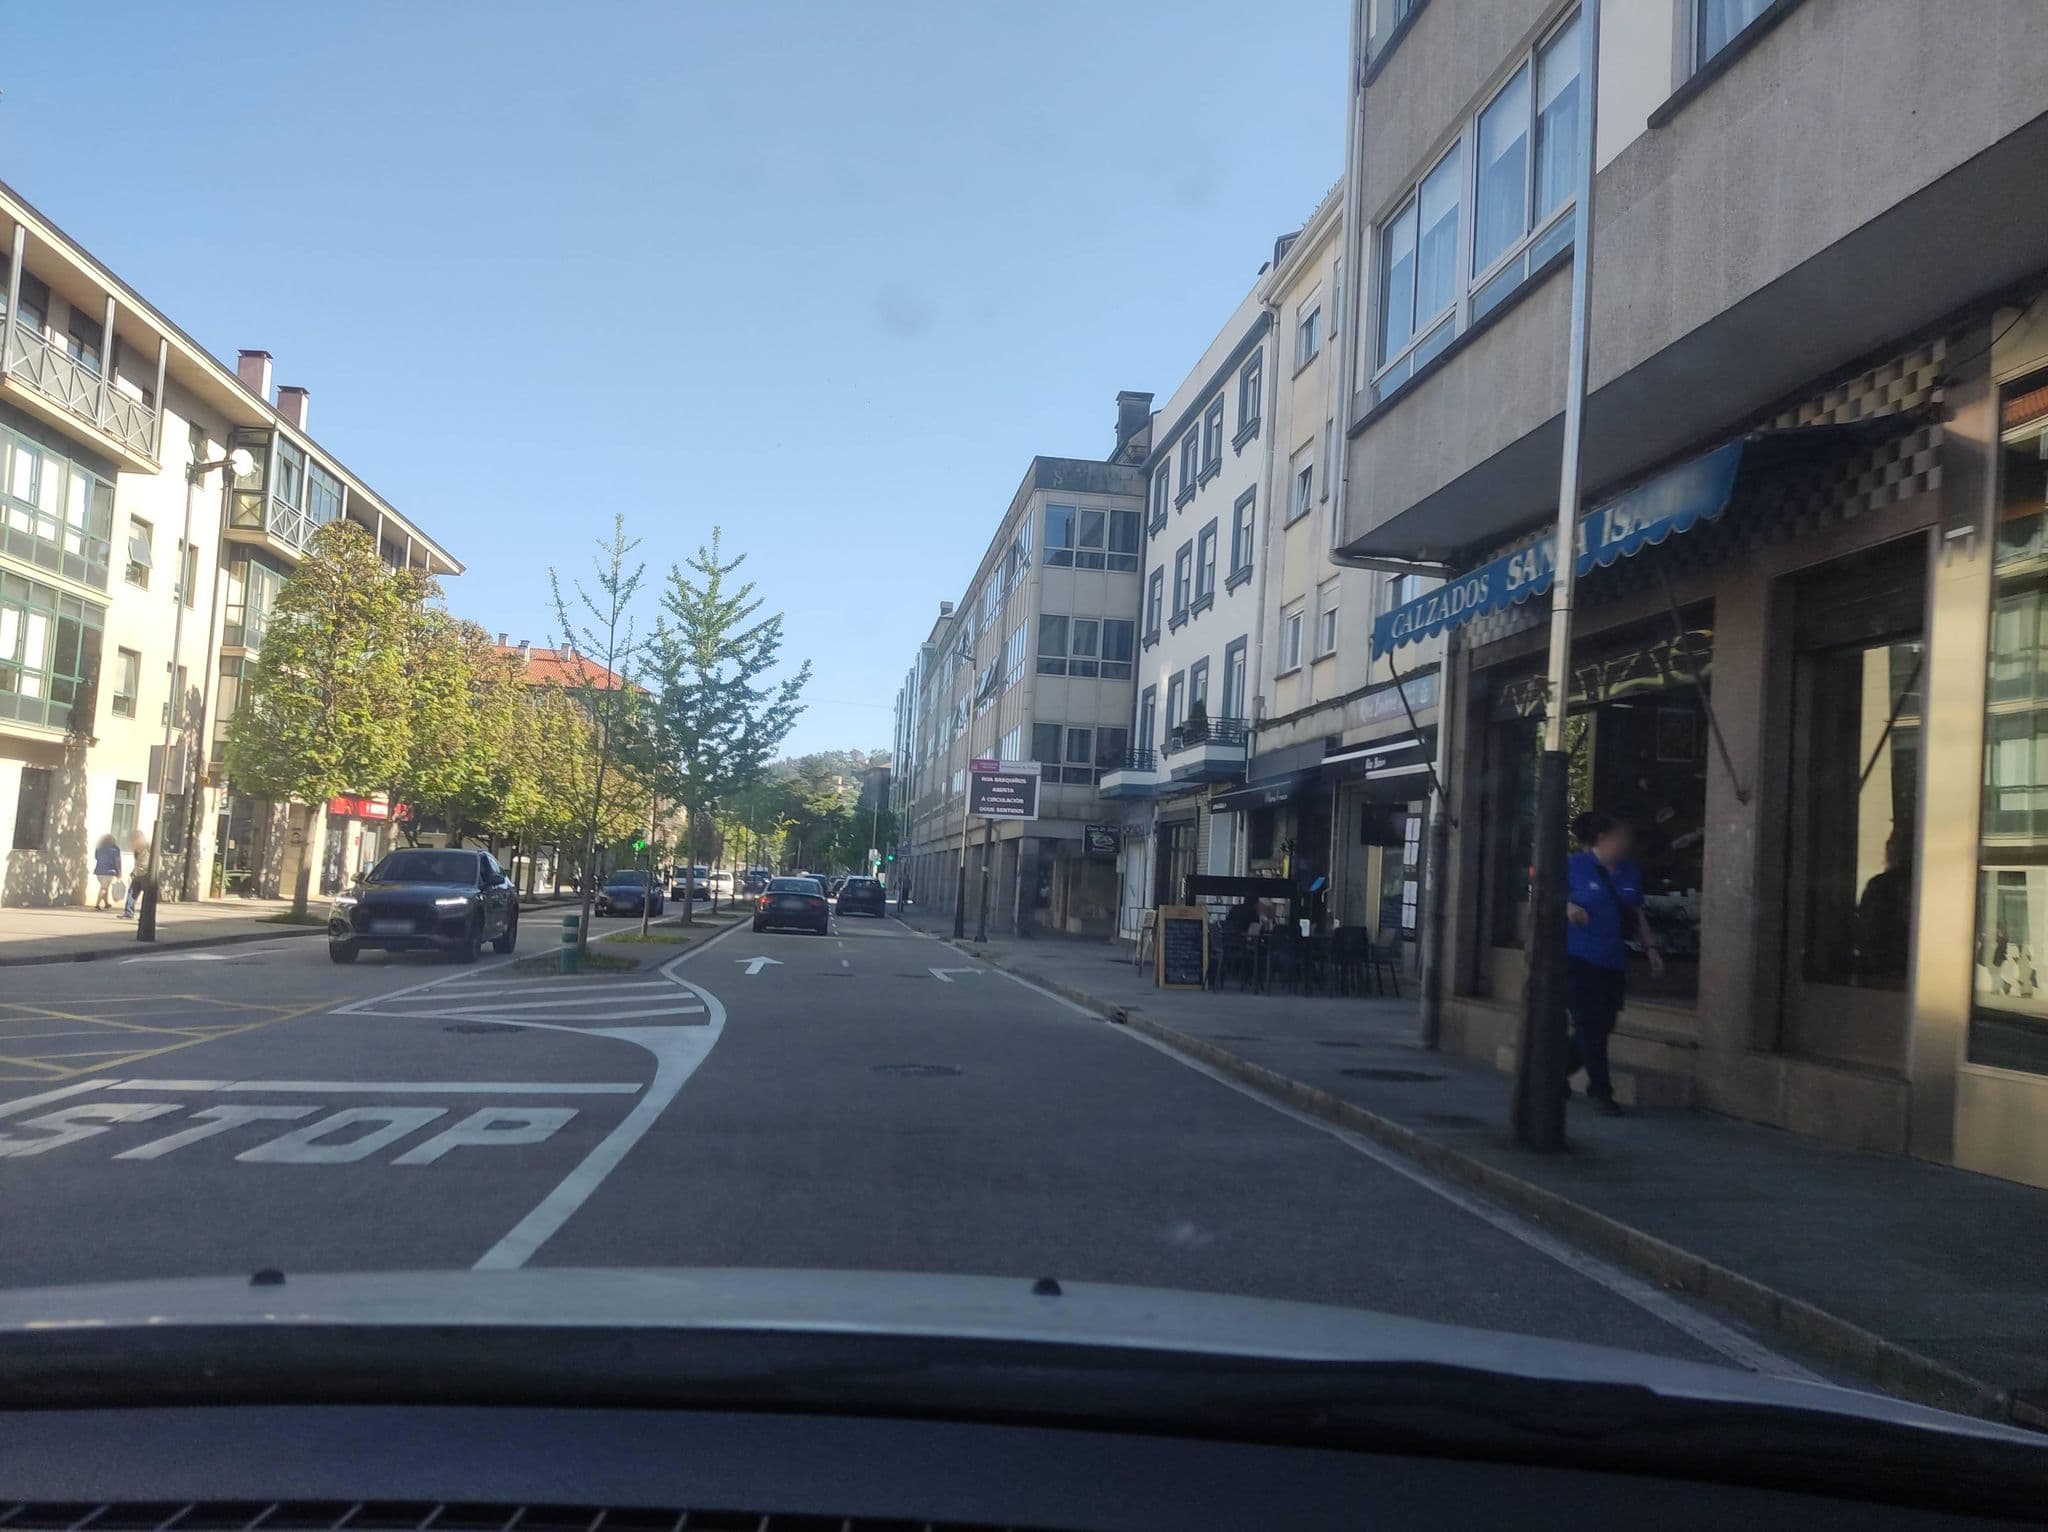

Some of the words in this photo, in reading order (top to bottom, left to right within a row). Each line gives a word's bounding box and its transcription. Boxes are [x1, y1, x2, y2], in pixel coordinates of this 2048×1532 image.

[1391, 574, 1489, 638] CALZADOS
[1505, 521, 1588, 591] SANA
[0, 1103, 580, 1166] STOP
